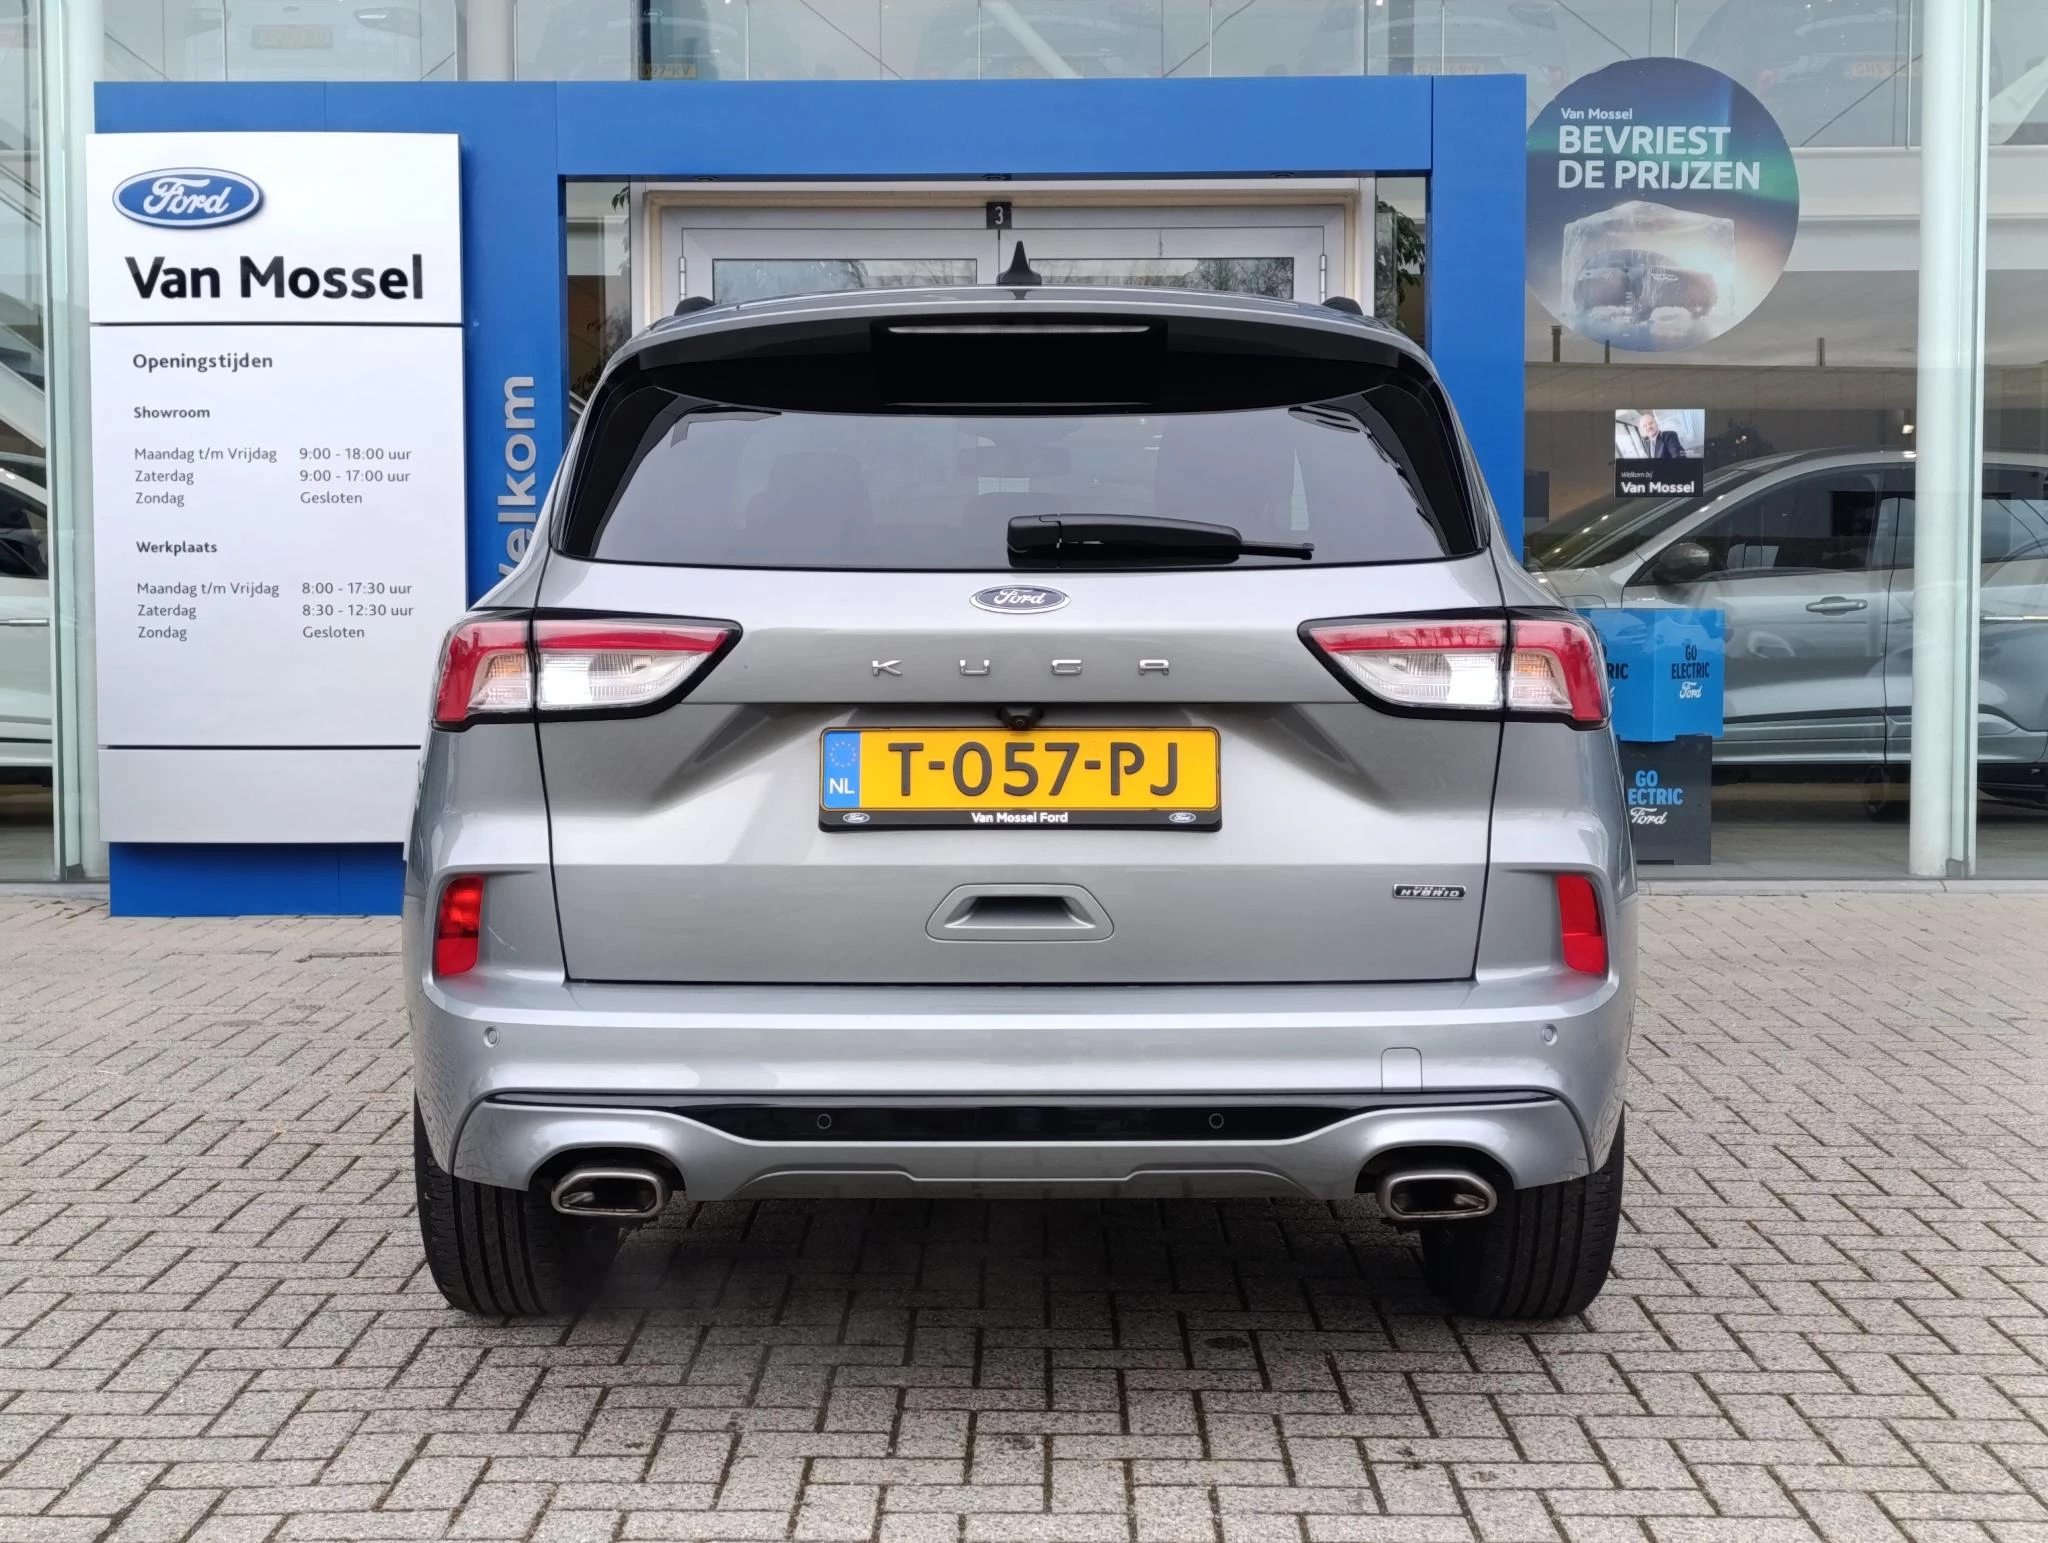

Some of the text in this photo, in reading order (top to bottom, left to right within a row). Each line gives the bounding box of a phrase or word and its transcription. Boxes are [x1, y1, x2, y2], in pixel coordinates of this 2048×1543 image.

[1561, 107, 1633, 120] Van Mossel
[1559, 125, 1731, 154] BEVRIEST
[1558, 160, 1760, 190] DE PRIJZEN
[143, 177, 232, 214] Ford
[994, 206, 1004, 225] 3
[124, 253, 423, 300] Van Mossel
[132, 352, 273, 373] Openingstijden
[133, 405, 211, 419] Showroom
[134, 447, 195, 464] Maandag
[199, 447, 224, 461] t/m
[227, 447, 278, 464] Vrijdag
[299, 447, 331, 461] 9:00
[345, 447, 385, 461] 18:00
[388, 450, 412, 461] uur
[135, 469, 195, 486] Zaterdag
[299, 469, 332, 483] 9:00
[345, 469, 384, 483] 17:00
[387, 472, 411, 483] uur
[496, 376, 538, 578] elkom
[1621, 480, 1695, 494] Van Mossel
[135, 491, 363, 508] Zondag Gesloten
[136, 540, 218, 557] Werkplaats
[136, 581, 197, 598] Maandag
[201, 582, 226, 595] t/m
[230, 581, 280, 598] Vrijdag
[301, 582, 334, 595] 8:00
[347, 582, 386, 595] 17:30
[389, 584, 413, 595] uur
[994, 588, 1048, 606] Ford
[137, 604, 197, 620] Zaterdag
[302, 604, 334, 617] 8:30
[348, 604, 387, 617] 12:30
[390, 606, 414, 617] uur
[138, 626, 366, 642] Zondag Gesloten
[1685, 644, 1698, 661] GO
[872, 658, 1170, 677] KUGA
[1671, 662, 1710, 680] ELECTRIC
[1679, 681, 1703, 699] Ford
[888, 742, 1178, 797] T-057-PJ
[1635, 769, 1659, 788] GO
[828, 777, 856, 795] NL
[1627, 787, 1685, 806] ECTRIC
[971, 811, 1069, 824] Van Mossel Ford
[1630, 806, 1669, 825] Ford
[1400, 888, 1460, 898] HYBRID
